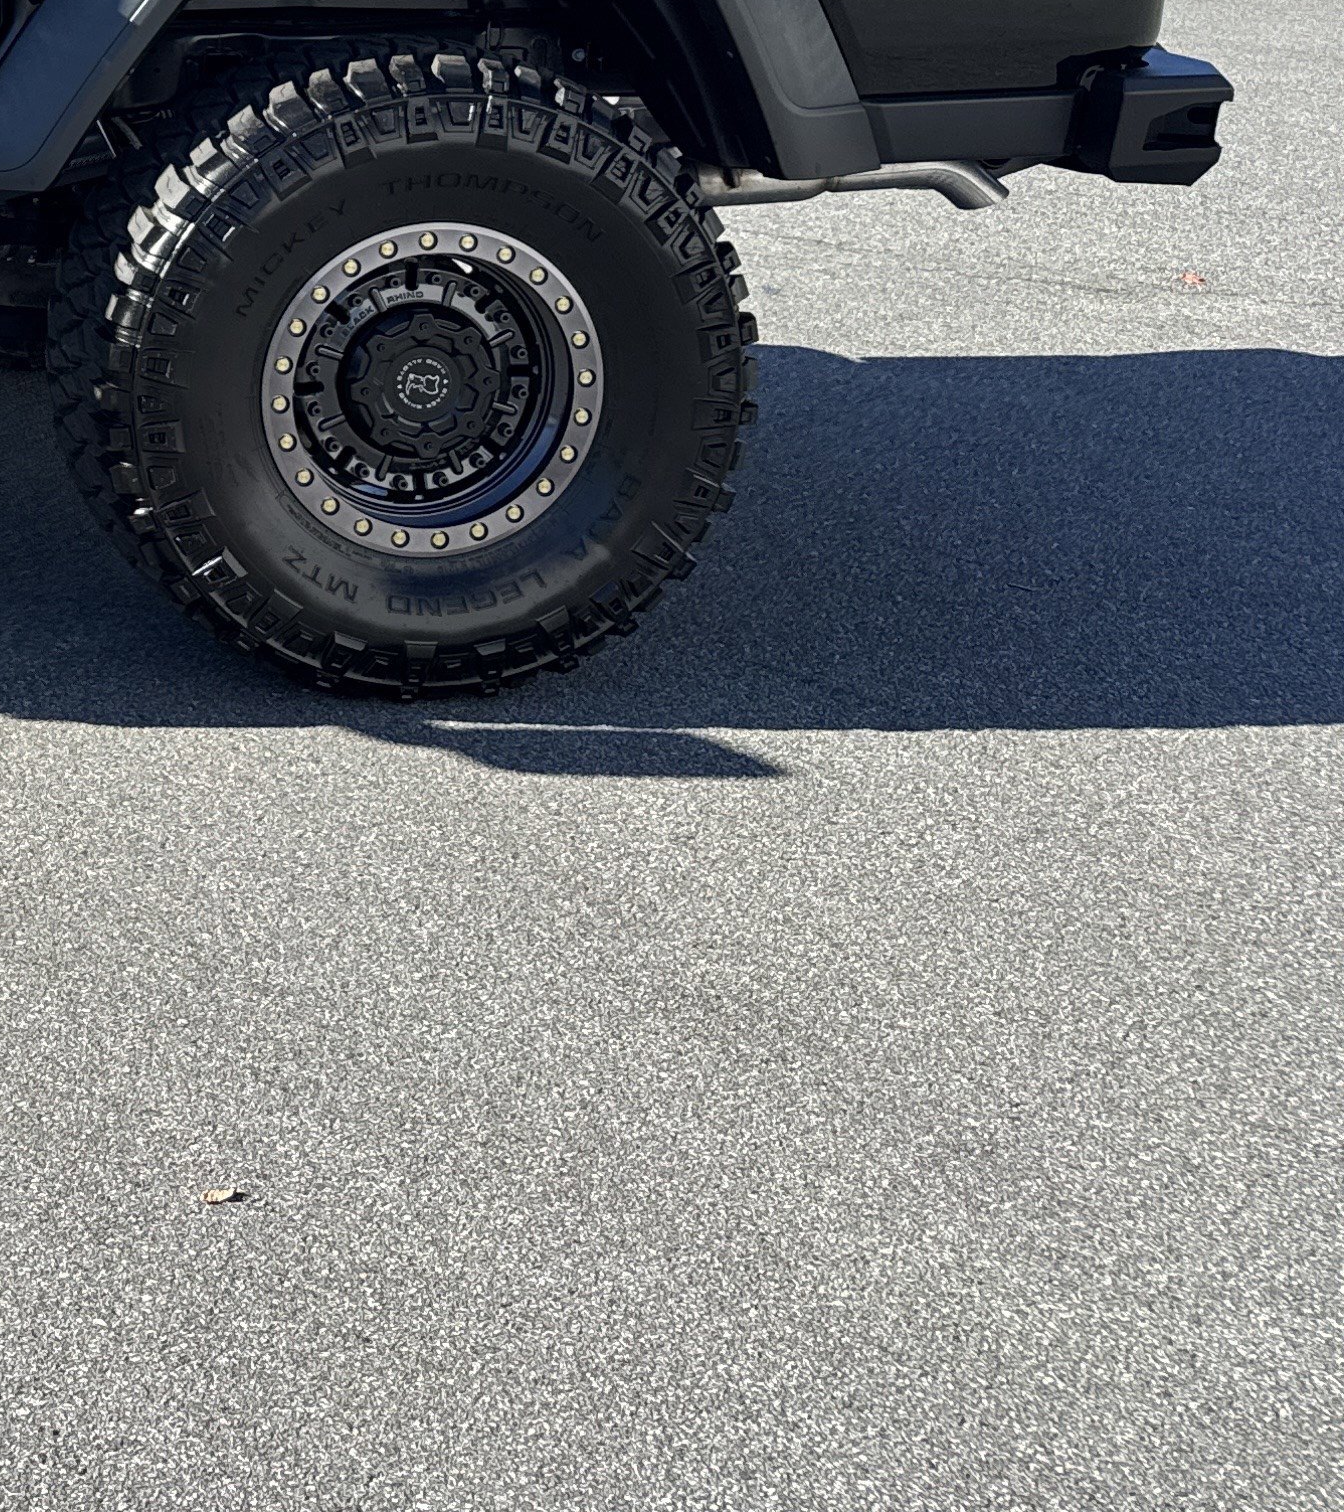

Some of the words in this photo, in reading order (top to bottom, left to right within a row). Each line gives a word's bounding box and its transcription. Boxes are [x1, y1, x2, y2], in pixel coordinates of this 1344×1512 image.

[235, 196, 347, 318] MICKEY
[377, 171, 606, 244] THOMPSON
[386, 291, 424, 305] RHINO
[563, 472, 642, 562] BAJA
[280, 544, 359, 606] MTZ
[386, 567, 550, 618] LEGEND
